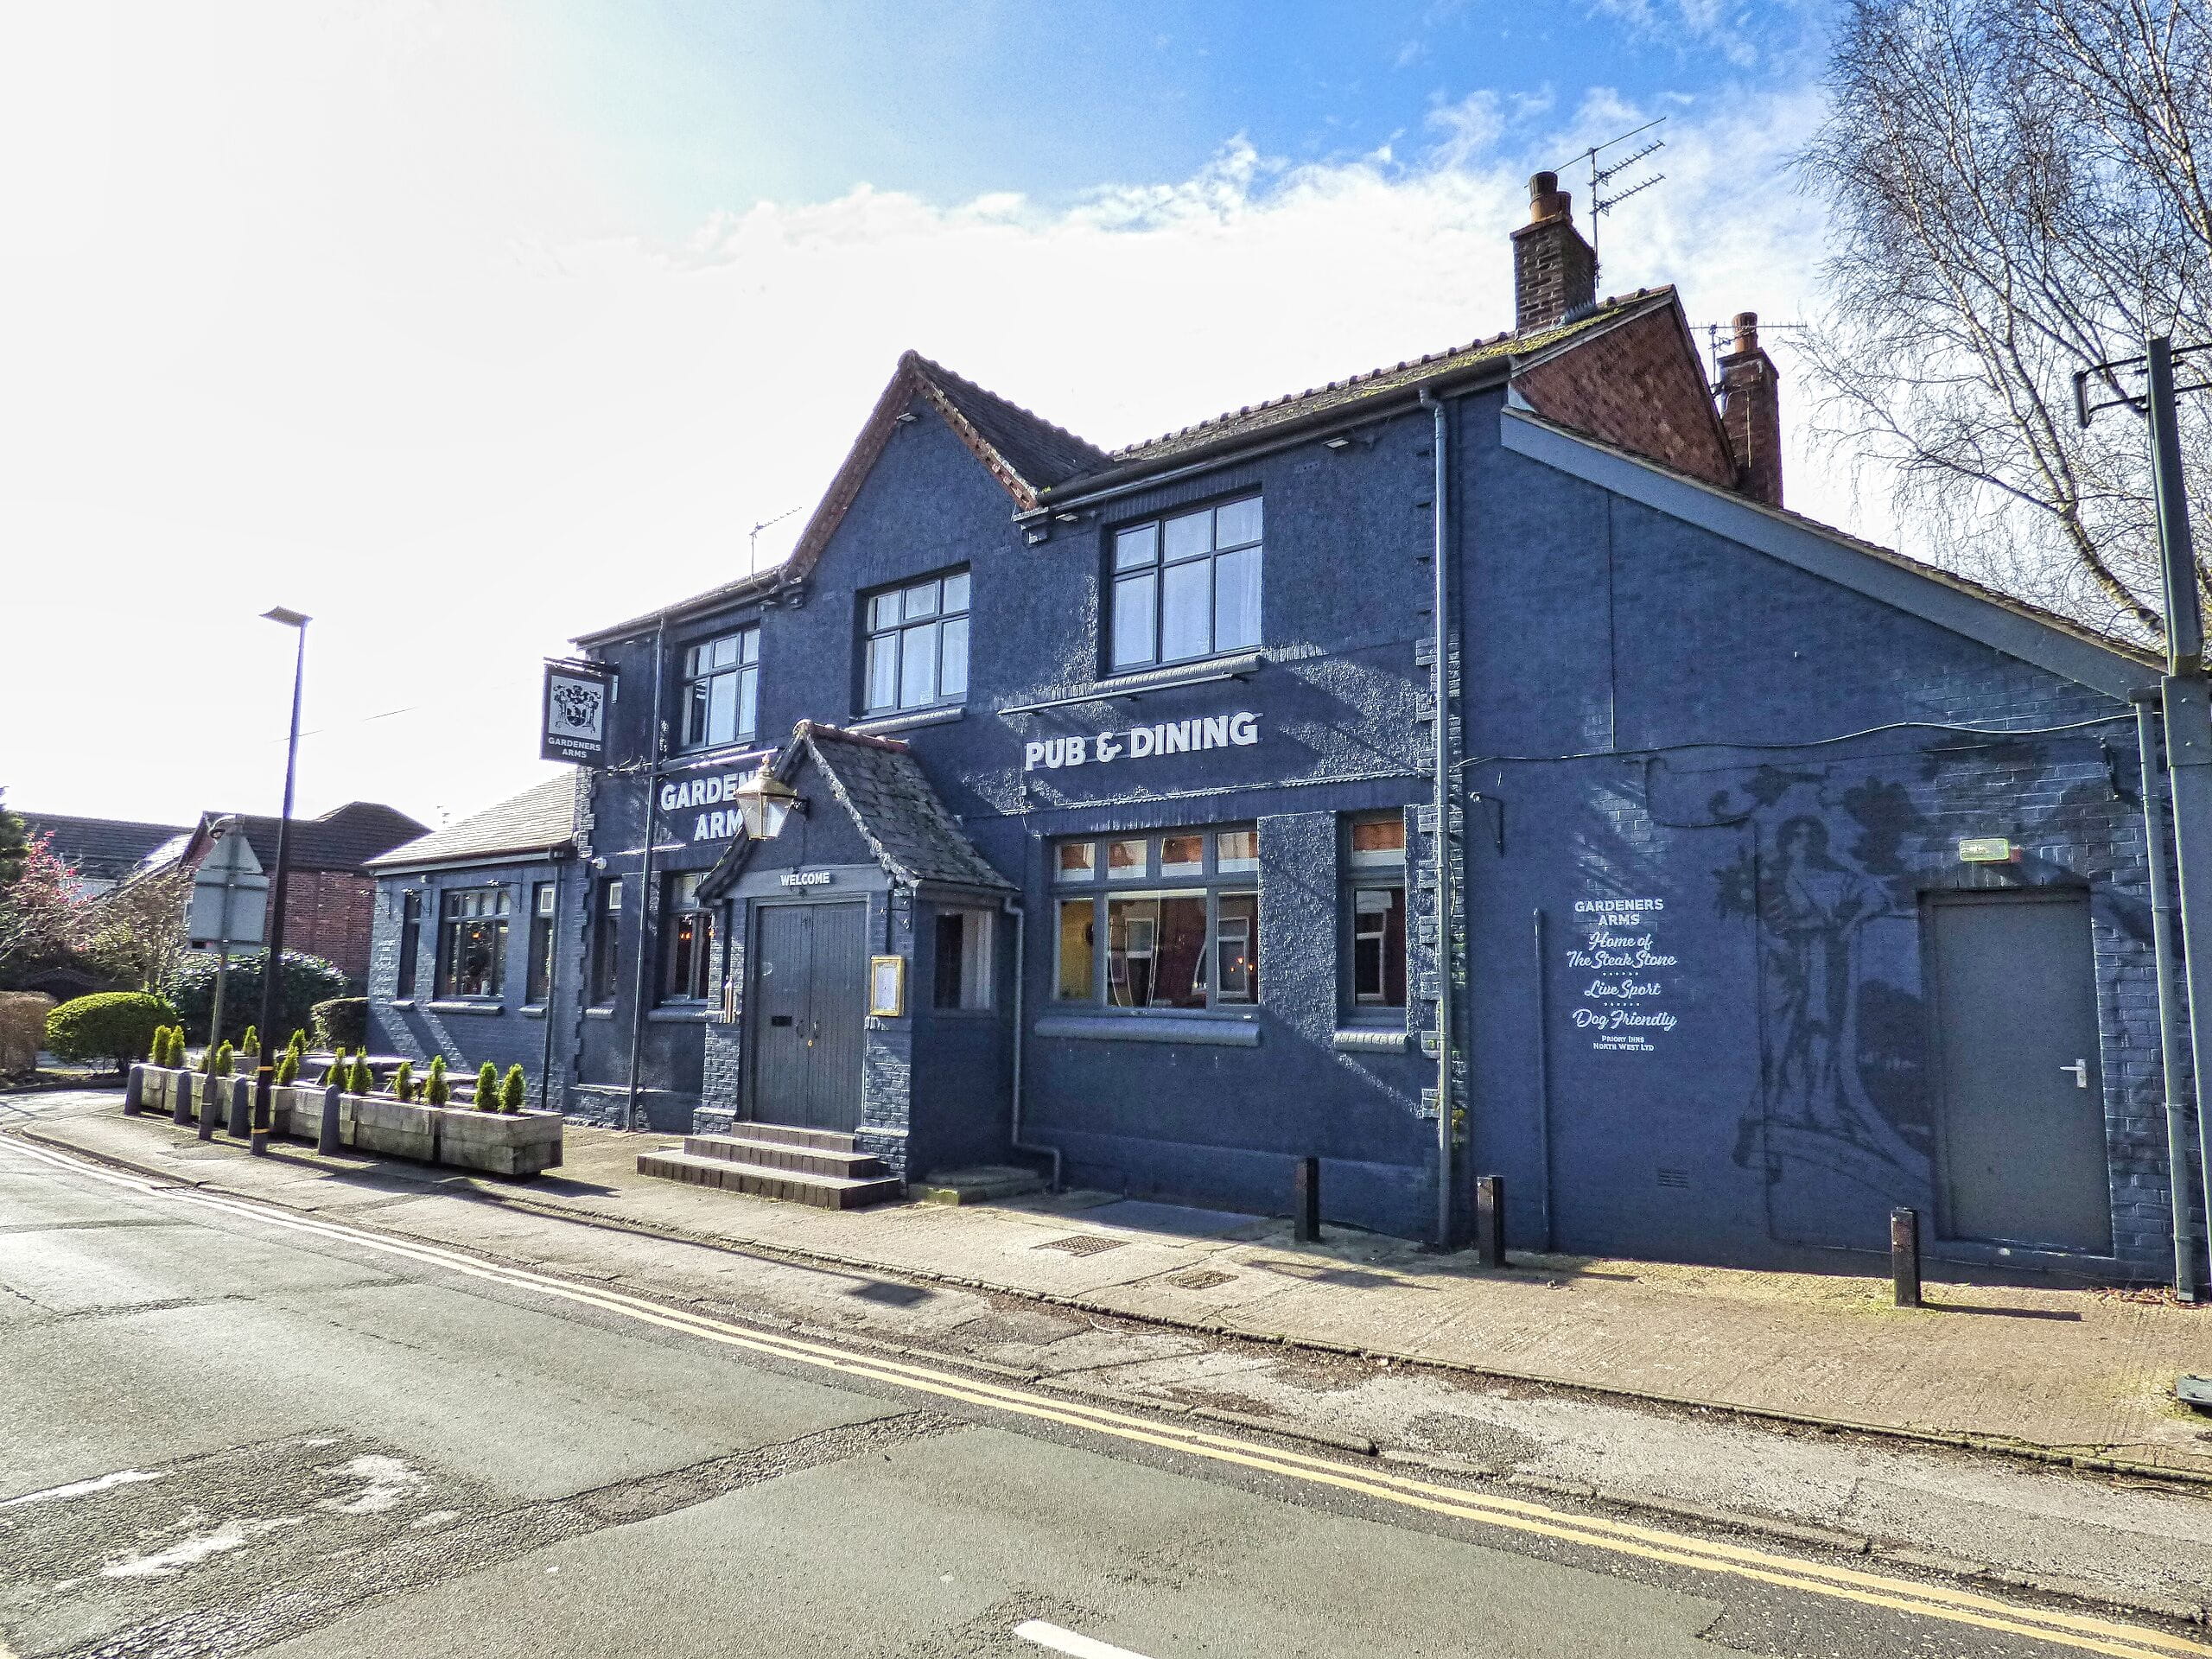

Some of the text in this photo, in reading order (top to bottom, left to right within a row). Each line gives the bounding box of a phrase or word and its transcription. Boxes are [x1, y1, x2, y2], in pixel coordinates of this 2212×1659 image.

[548, 737, 601, 752] GARDENERS
[1025, 712, 1259, 772] PUB & DINING
[562, 748, 588, 759] ARMS
[660, 770, 760, 811] GARDE
[693, 808, 744, 842] ARM
[779, 872, 830, 887] WELCOME
[1574, 899, 1664, 912] GARDENERS
[1599, 913, 1641, 926] ARMS
[1588, 931, 1654, 950] Home of
[1567, 950, 1678, 969] The Steak Stone
[1584, 979, 1662, 999] Live Sport
[1572, 1008, 1678, 1032] Dog Friendly
[1640, 1043, 1655, 1052] LTD
